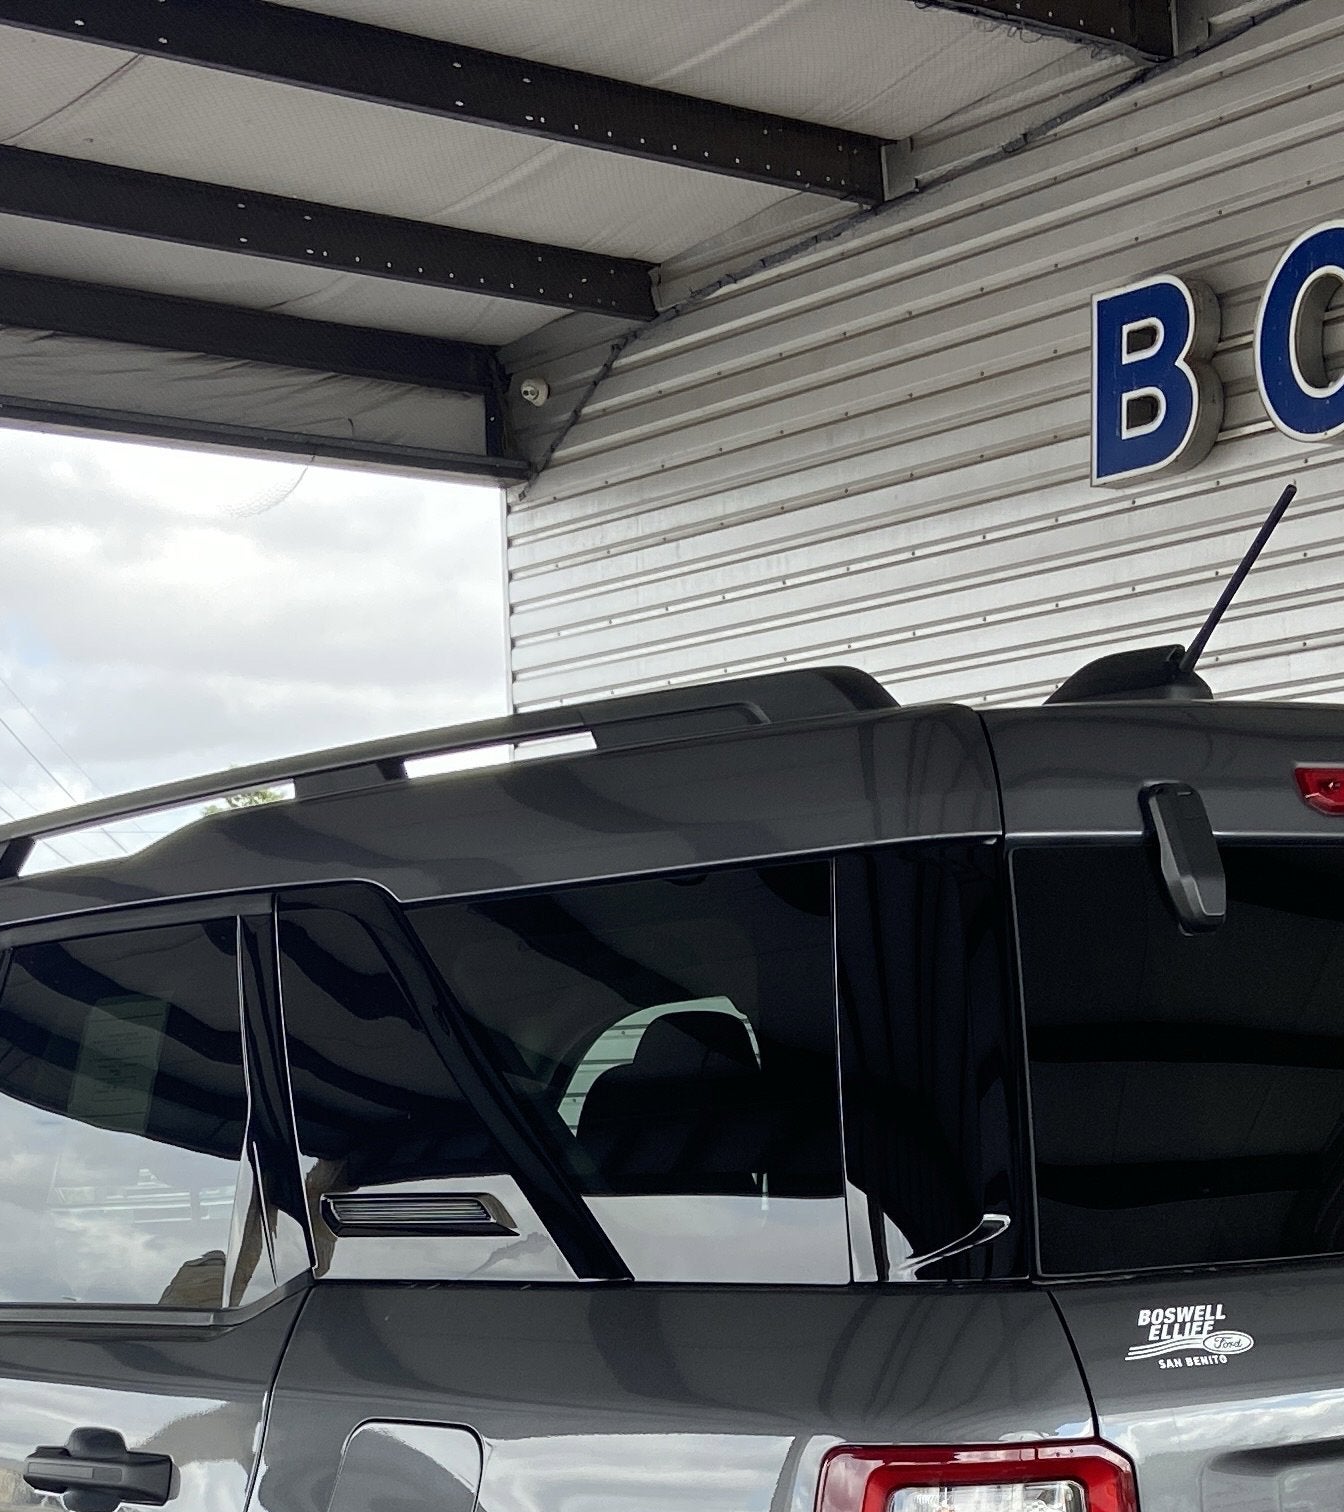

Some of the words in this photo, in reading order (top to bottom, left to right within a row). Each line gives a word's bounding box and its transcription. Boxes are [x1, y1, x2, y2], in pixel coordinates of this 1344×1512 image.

[1137, 1303, 1226, 1326] BOSWELL
[1148, 1320, 1214, 1341] ELLIFF
[1213, 1336, 1243, 1349] Ford
[1158, 1357, 1183, 1369] SAN
[1185, 1354, 1228, 1367] BENITO
